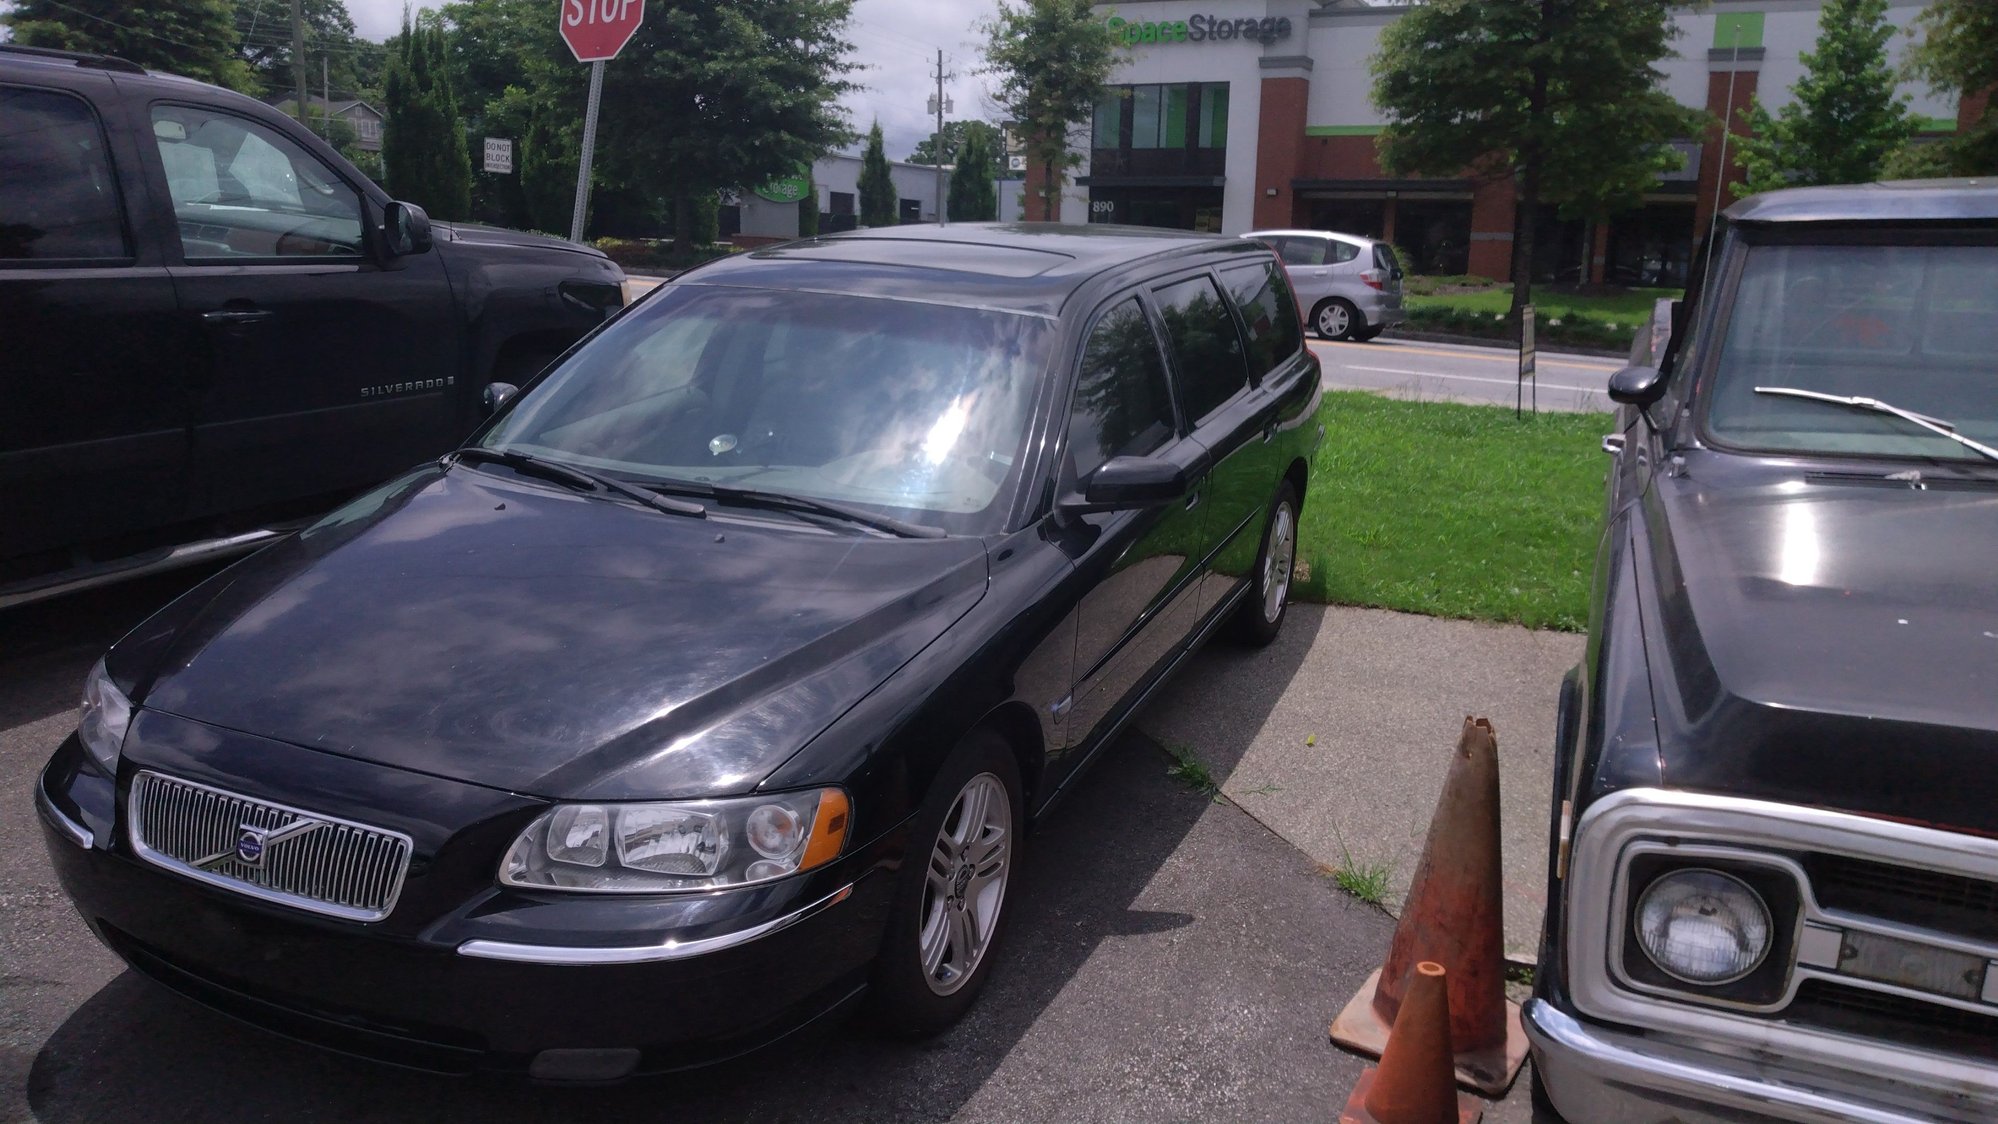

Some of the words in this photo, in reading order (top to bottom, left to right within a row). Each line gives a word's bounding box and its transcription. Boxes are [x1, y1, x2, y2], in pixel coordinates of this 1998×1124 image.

[486, 142, 496, 151] DO
[497, 143, 510, 152] NOT
[486, 152, 510, 162] BLOCK
[1093, 200, 1114, 213] 890
[361, 378, 443, 397] SILVERADO
[240, 842, 260, 851] VOLVO
